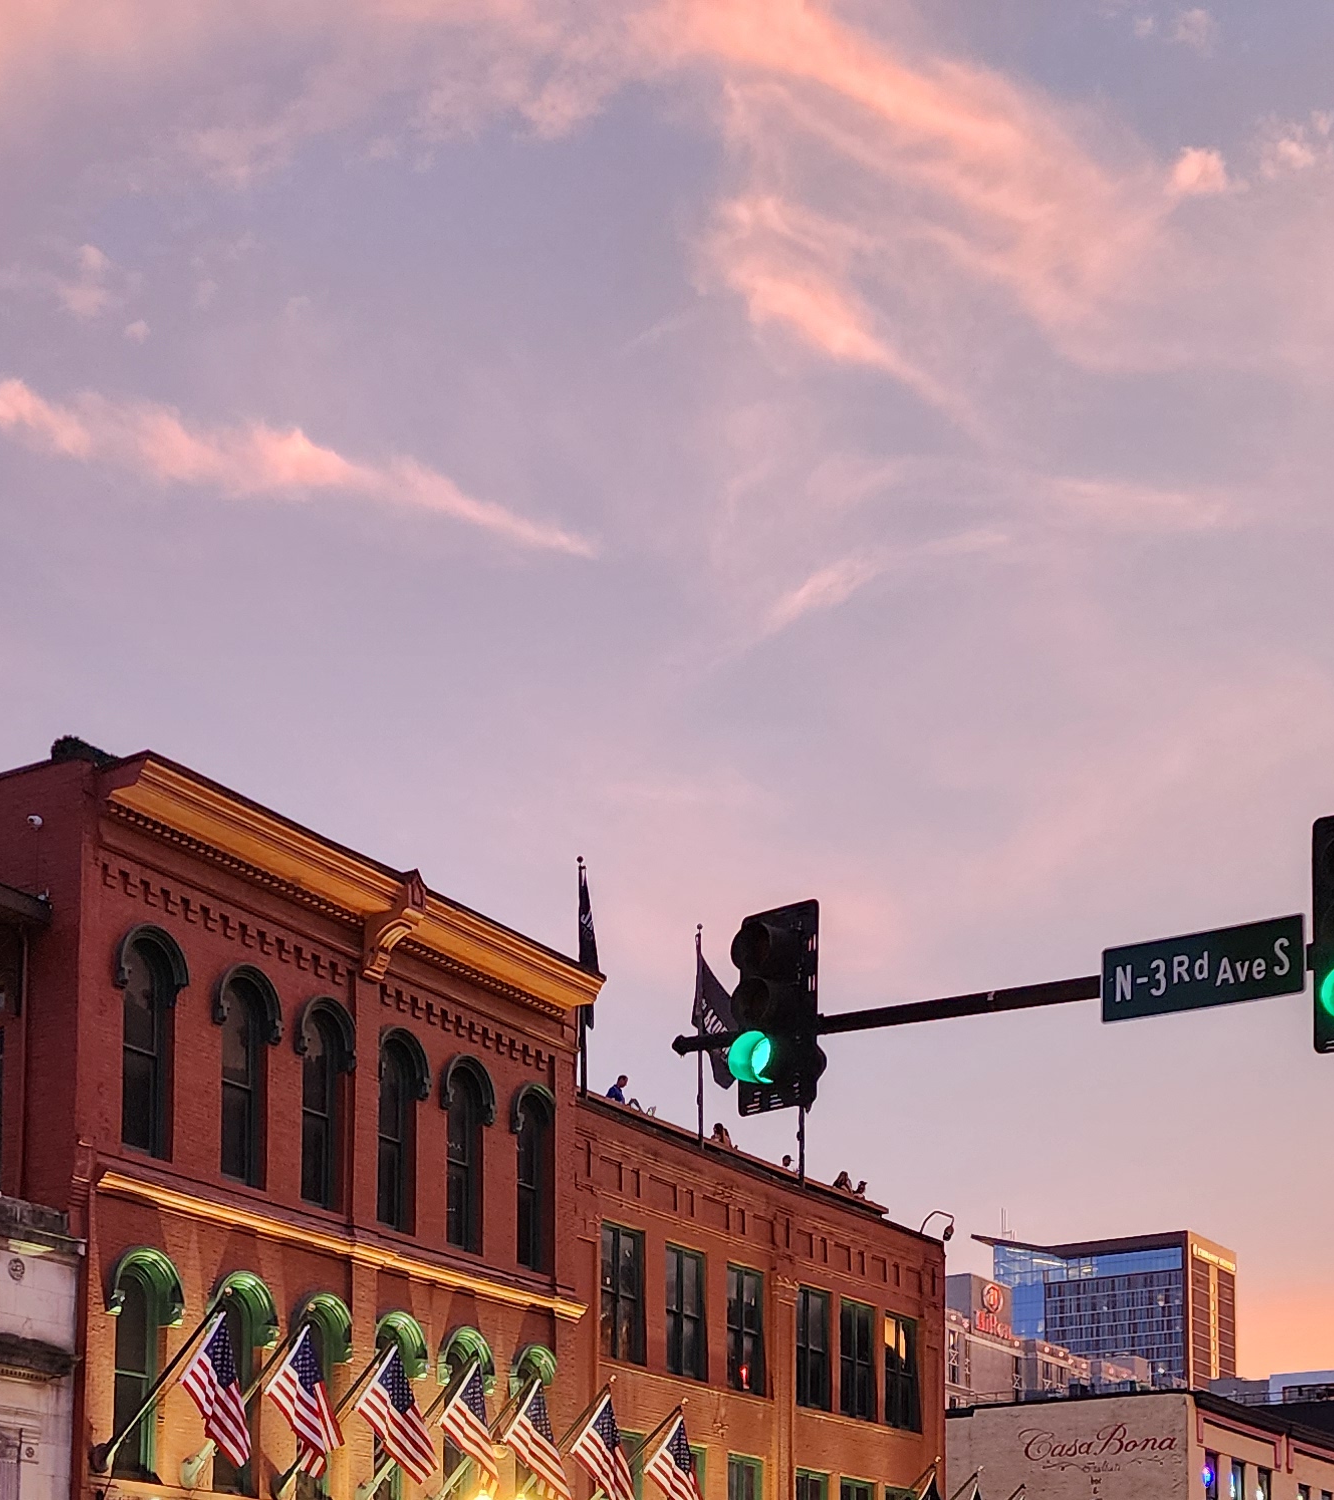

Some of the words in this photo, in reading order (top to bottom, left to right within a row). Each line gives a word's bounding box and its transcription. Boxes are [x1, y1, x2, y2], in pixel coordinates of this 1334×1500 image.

[1214, 956, 1267, 987] Ave
[1273, 937, 1290, 976] S
[974, 1309, 1012, 1340] Hilton
[1018, 1427, 1094, 1461] Casa
[1094, 1422, 1178, 1456] Bona
